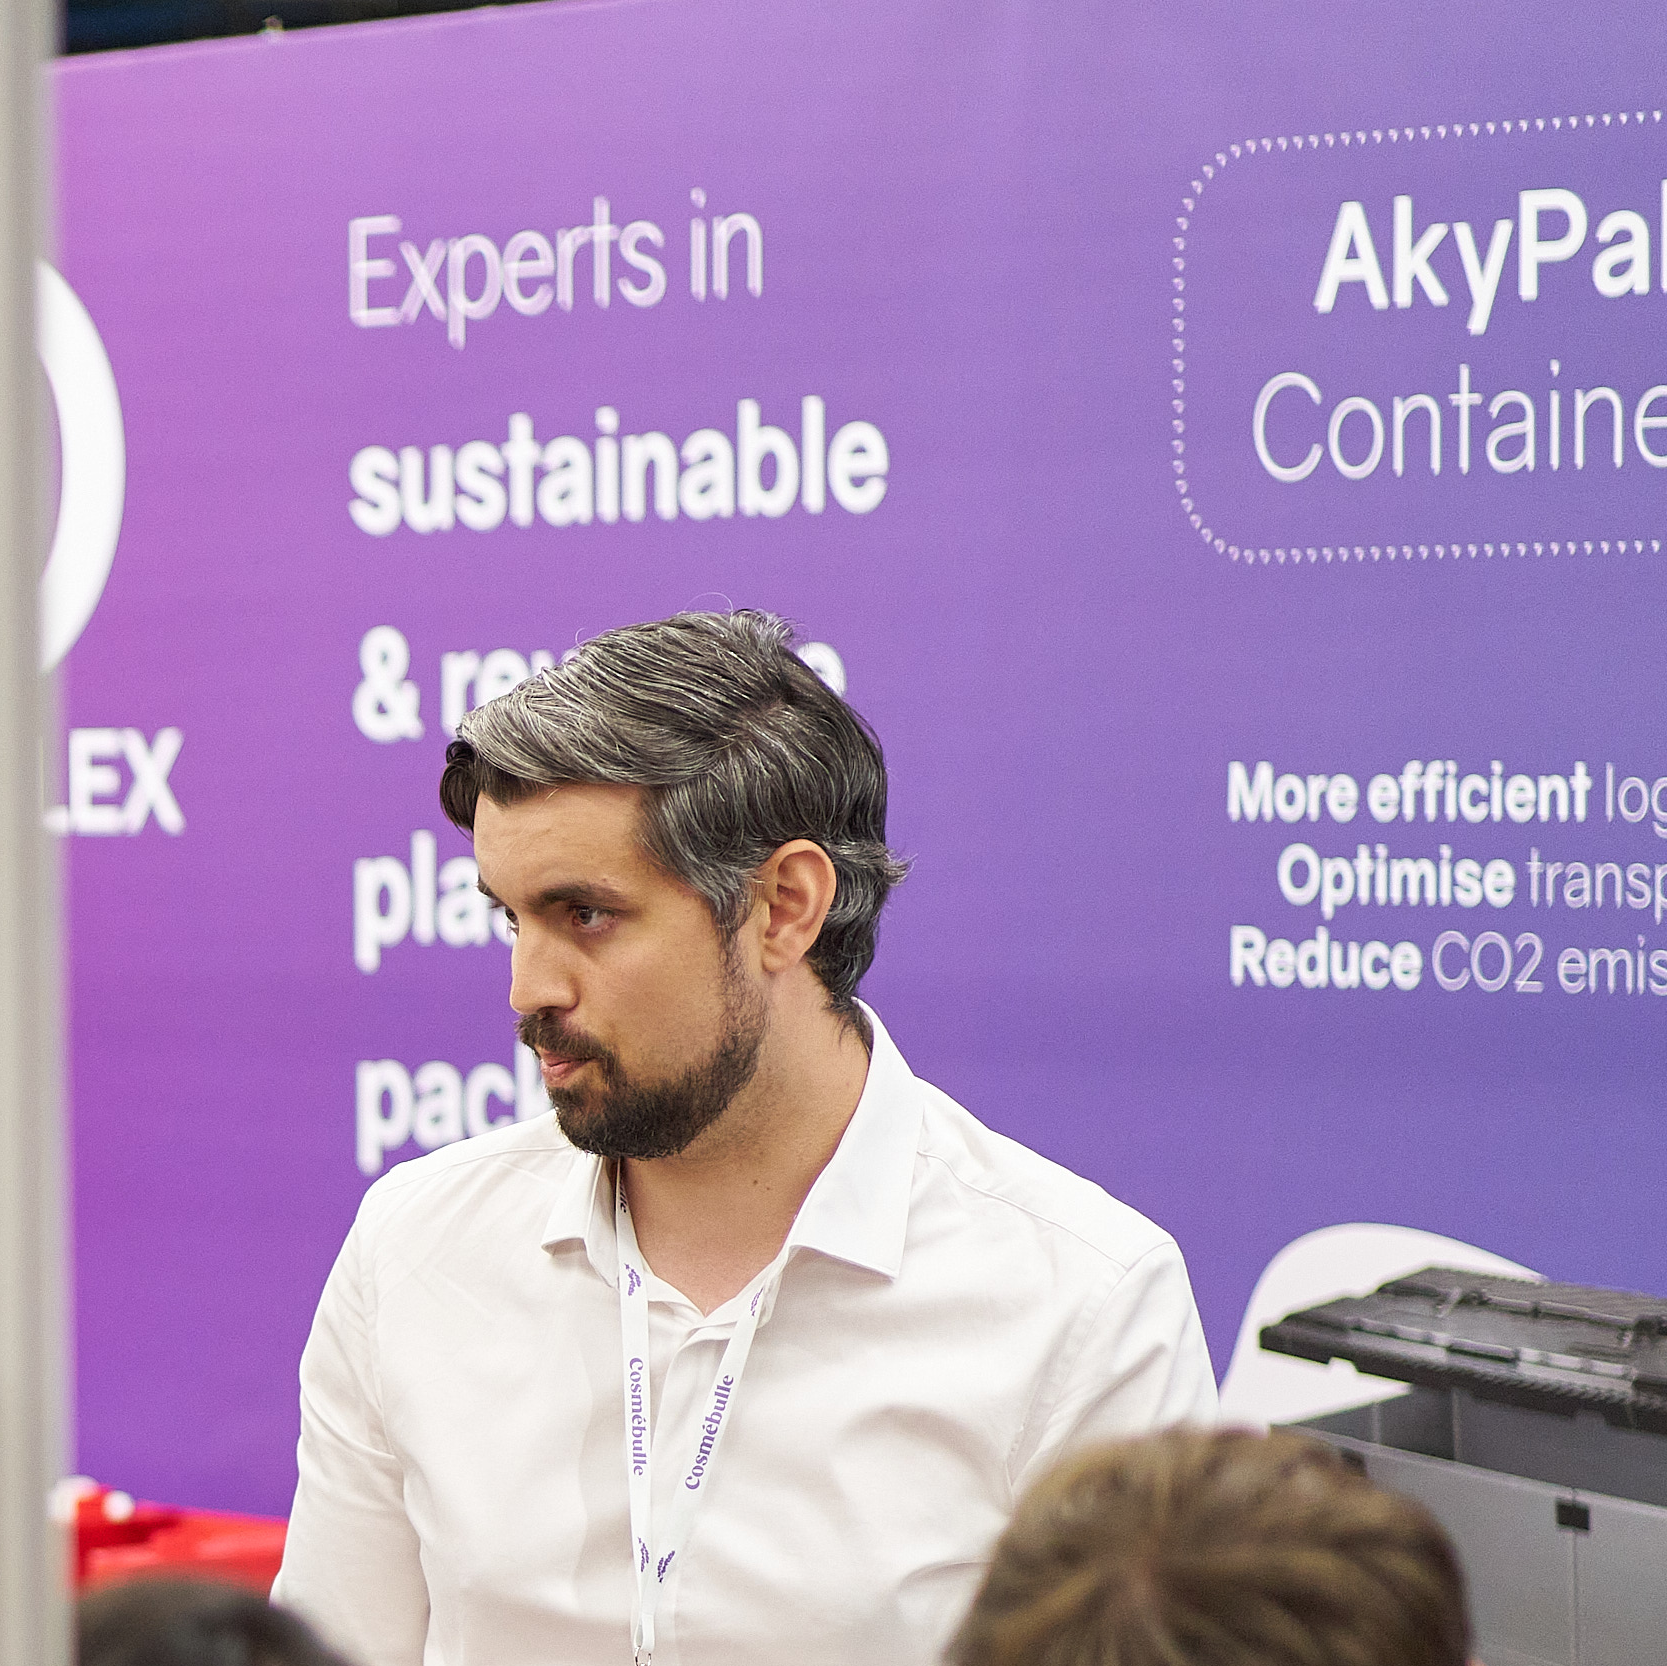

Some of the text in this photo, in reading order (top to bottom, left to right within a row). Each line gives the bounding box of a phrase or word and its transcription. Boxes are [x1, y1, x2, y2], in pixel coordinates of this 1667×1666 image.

[348, 186, 763, 350] Experts in
[348, 393, 891, 537] sustainable
[352, 624, 425, 743] &
[1227, 760, 1360, 825] More
[1367, 758, 1594, 824] efficient
[1277, 842, 1516, 922] Optimise
[1229, 924, 1424, 991] Reduce
[1431, 929, 1545, 993] CO2
[628, 1356, 646, 1477] Cosmébulle
[684, 1374, 735, 1491] Cosmébulle
